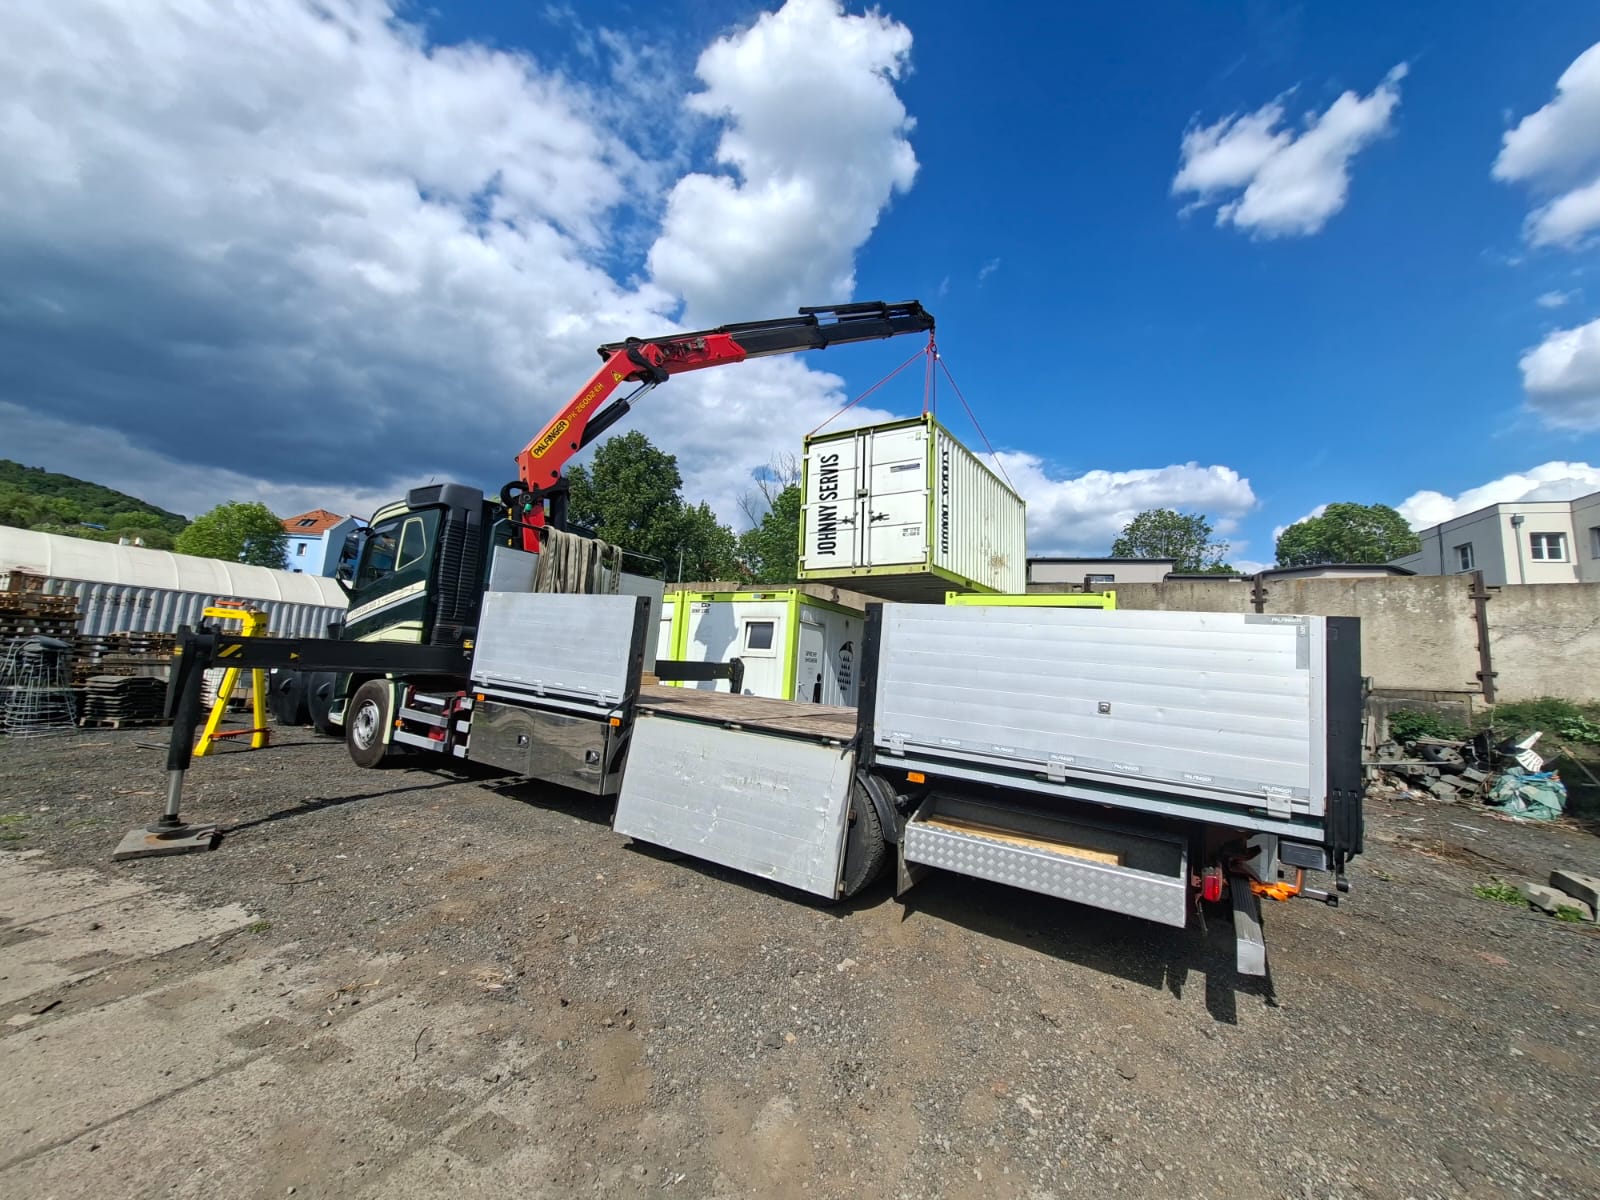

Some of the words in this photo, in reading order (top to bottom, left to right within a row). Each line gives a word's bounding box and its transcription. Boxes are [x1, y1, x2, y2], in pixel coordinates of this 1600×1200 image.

[533, 420, 567, 456] PALFINGER
[567, 411, 577, 422] PK
[819, 453, 839, 500] SERVIS
[817, 505, 838, 556] JOHNNY
